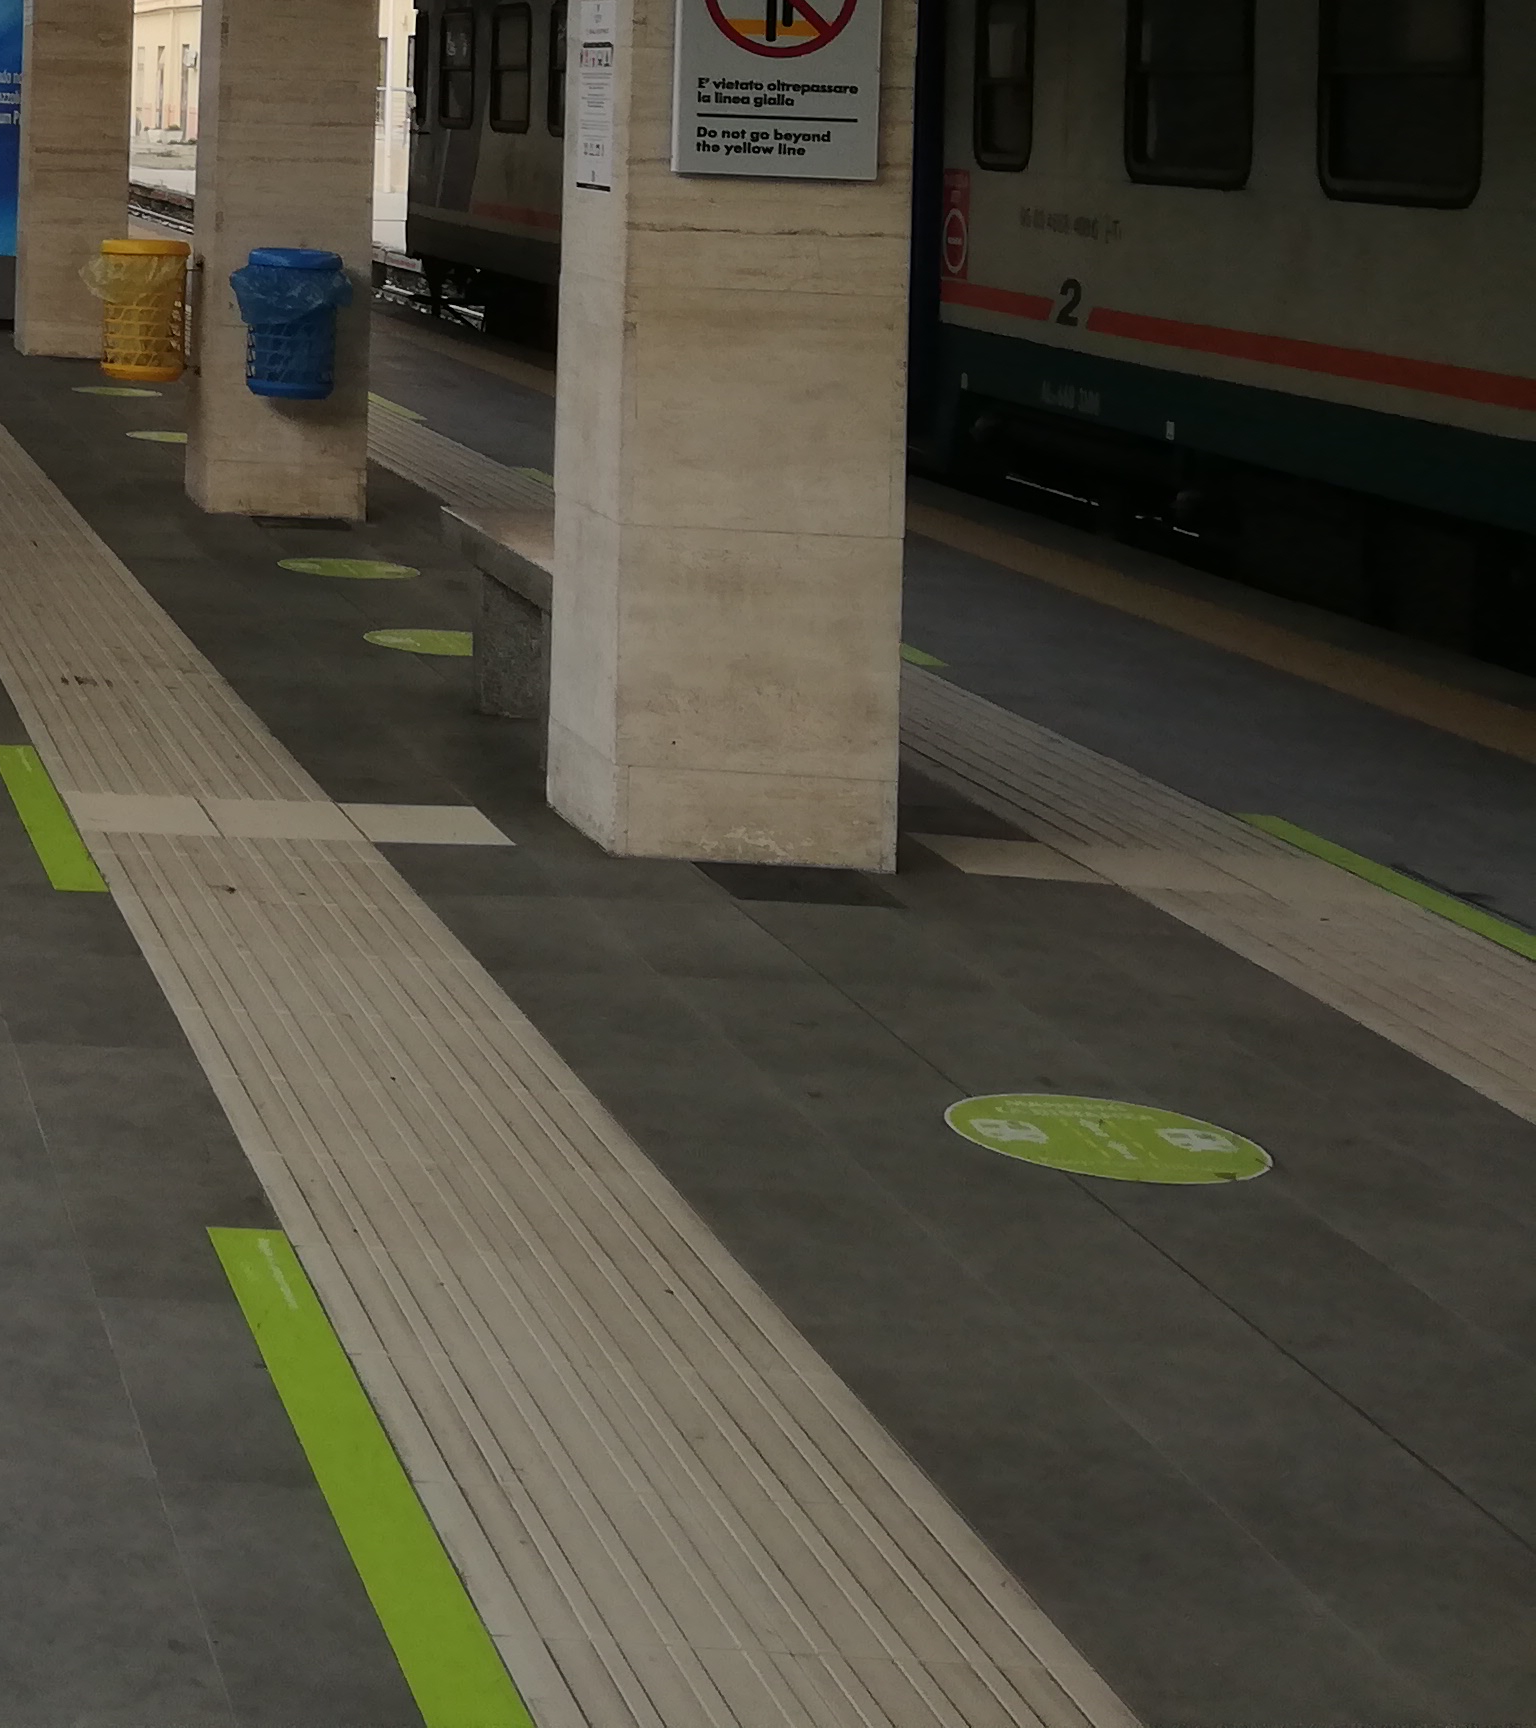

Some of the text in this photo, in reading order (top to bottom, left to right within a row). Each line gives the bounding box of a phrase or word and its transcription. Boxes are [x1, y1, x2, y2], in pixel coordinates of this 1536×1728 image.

[713, 77, 764, 91] vietato
[767, 79, 859, 96] oltrepassare
[697, 91, 795, 108] la linea gialla
[696, 126, 831, 144] Do not go beyond
[696, 140, 806, 156] the yellow line
[1056, 278, 1083, 327] 2
